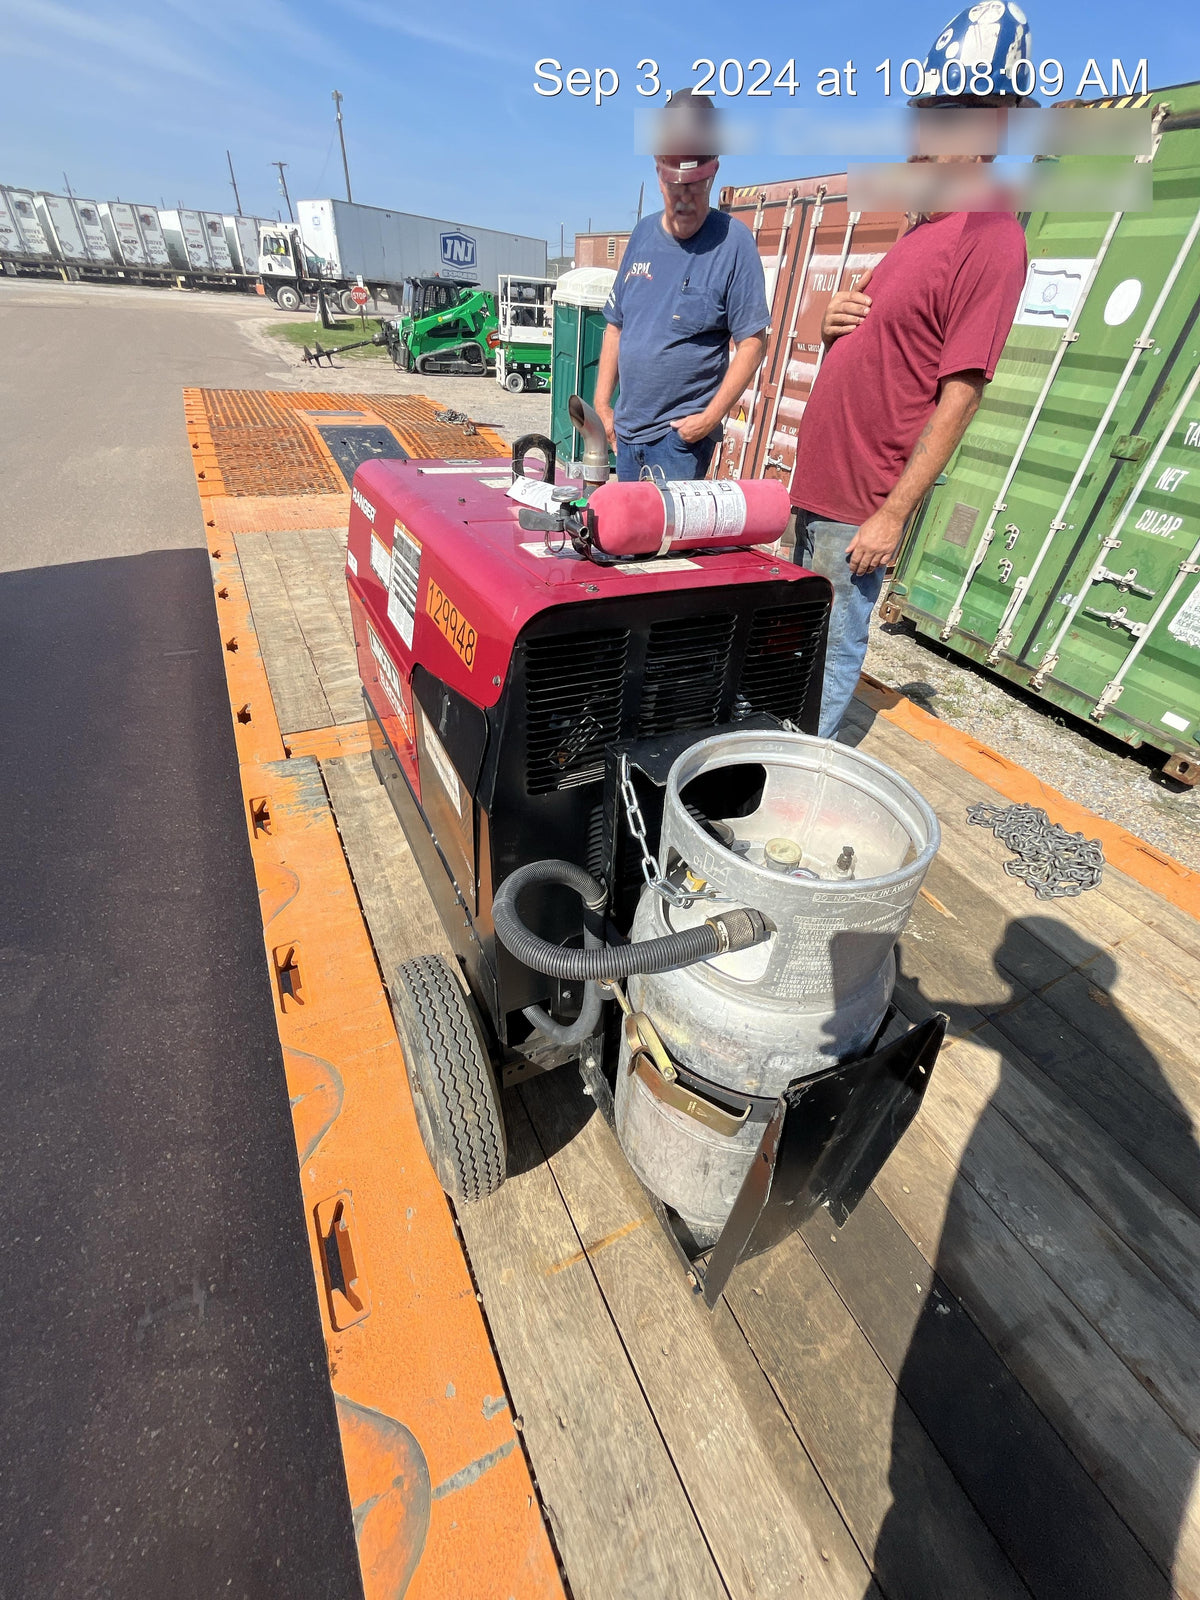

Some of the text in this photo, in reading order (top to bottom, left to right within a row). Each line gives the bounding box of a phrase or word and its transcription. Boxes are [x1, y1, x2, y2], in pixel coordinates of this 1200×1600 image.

[443, 239, 474, 262] JNJ
[631, 262, 651, 275] SPM
[812, 273, 836, 292] TRLU
[352, 292, 367, 300] STOP
[1155, 467, 1190, 493] NET
[352, 487, 376, 524] RANGER
[428, 581, 477, 667] 129948
